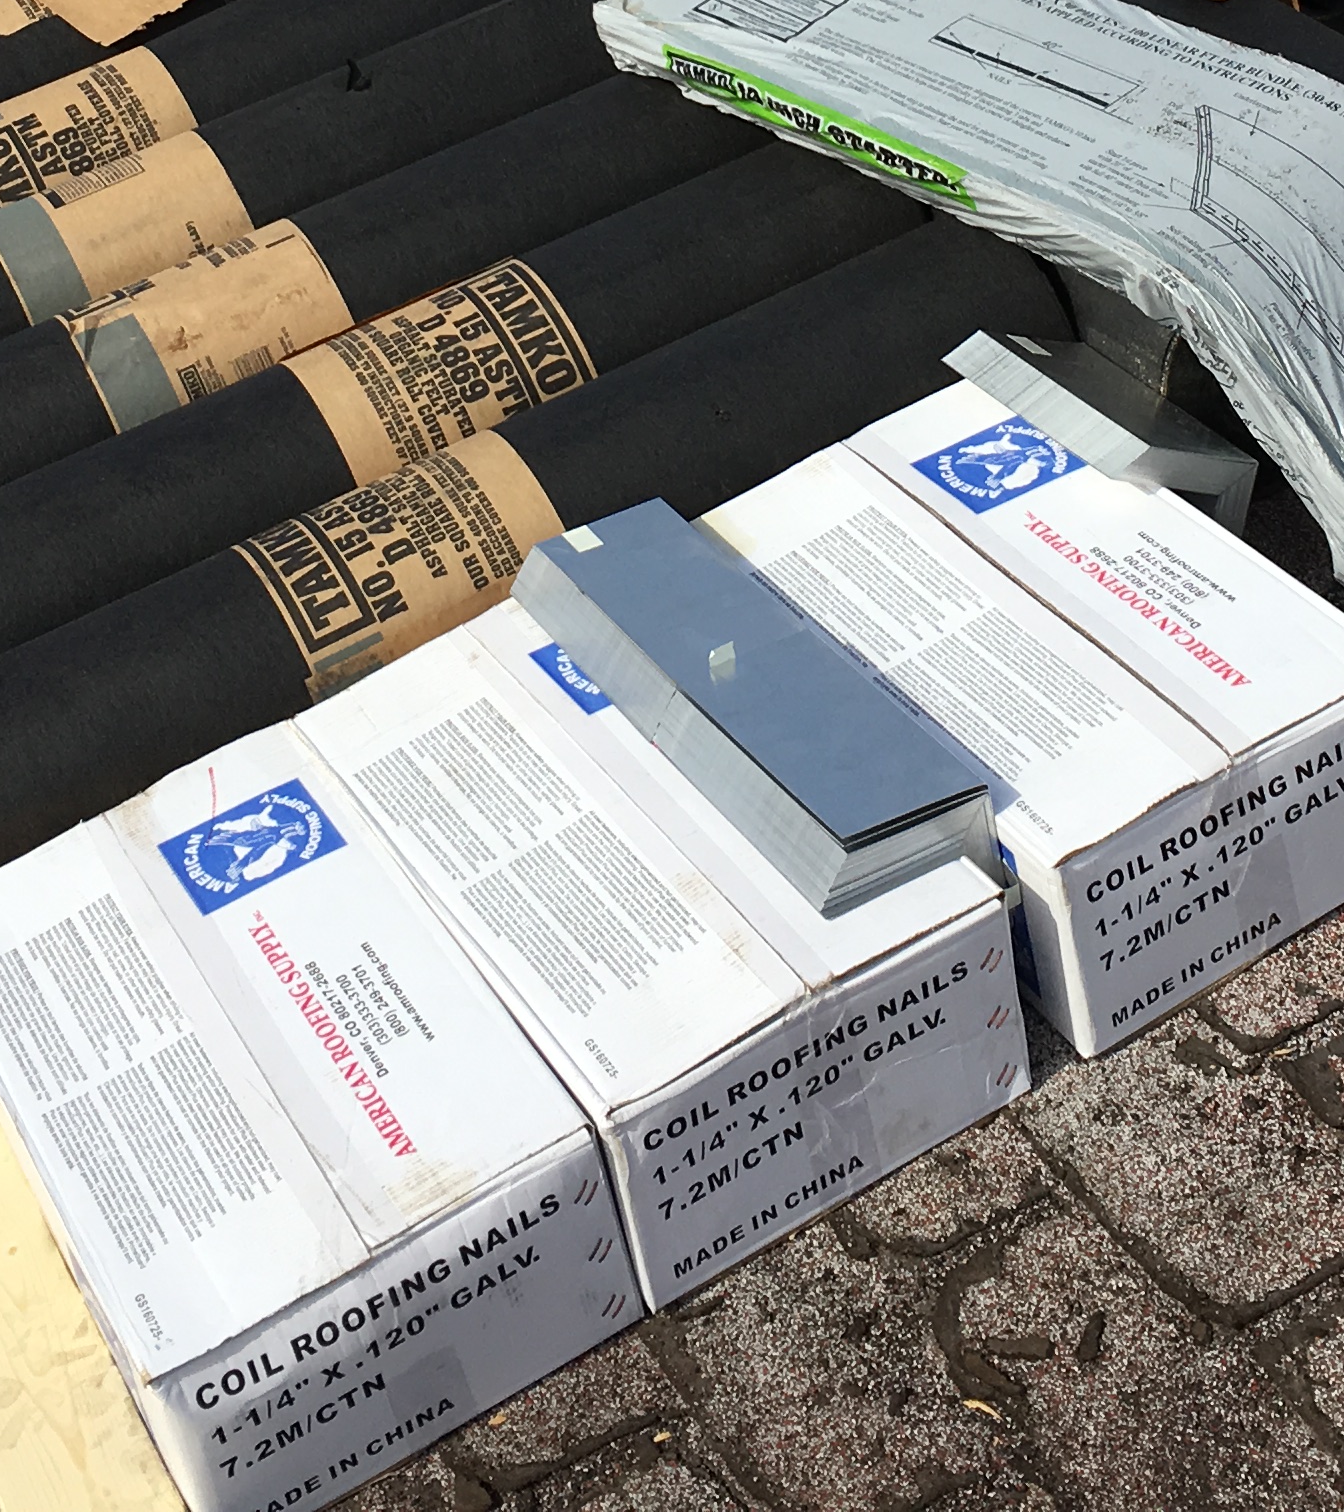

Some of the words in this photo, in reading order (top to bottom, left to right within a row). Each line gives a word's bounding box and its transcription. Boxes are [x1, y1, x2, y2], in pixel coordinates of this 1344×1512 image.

[1044, 5, 1096, 29] APPLIED
[1093, 27, 1171, 58] ACCORDING
[1172, 51, 1193, 65] TO
[1191, 59, 1294, 103] INSTRUCTIONS
[1127, 26, 1150, 38] 100
[1147, 32, 1200, 56] LINEAR
[1198, 50, 1218, 63] FT
[1217, 54, 1247, 73] PER
[1246, 65, 1307, 93] BUNDLE
[1302, 85, 1342, 114] (30.48
[12, 112, 68, 178] ASTM
[53, 127, 95, 177] 869
[88, 116, 113, 151] FELT
[109, 125, 133, 159] ROLL
[416, 311, 447, 333] D
[434, 333, 491, 405] 4869
[452, 311, 492, 342] 15
[477, 272, 578, 396] TAMKO
[368, 329, 405, 368] SQUARE
[396, 367, 426, 404] ROLL
[389, 330, 430, 378] ORGANIC
[420, 378, 451, 417] FELT
[391, 314, 432, 353] ASPHALT
[423, 352, 477, 439] SATURATED
[382, 419, 401, 446] FEET
[995, 424, 1047, 441] SUPPLY
[937, 454, 1004, 500] AMERICAN
[333, 527, 376, 562] 15
[397, 512, 449, 580] ASPHALT
[404, 487, 448, 544] ORGANIC
[427, 496, 471, 554] SQUARE
[1022, 518, 1089, 568] SUPPLY
[381, 537, 420, 567] D
[477, 538, 504, 579] COVERS
[1089, 545, 1148, 590] 80217-2688
[1122, 554, 1196, 606] (303)333-3700
[1135, 547, 1185, 581] 249-3701
[1136, 530, 1238, 604] www.amroofing.com
[360, 559, 410, 625] NO.
[1080, 561, 1164, 621] ROOFING
[1145, 588, 1164, 602] CO
[1164, 598, 1203, 630] Denver,
[1180, 577, 1211, 600] (800)
[557, 648, 601, 695] MERICA
[1153, 614, 1254, 688] AMERICAN
[257, 793, 312, 816] SUPPLY
[298, 809, 324, 860] ROOFING
[182, 832, 240, 895] AMERICAN
[1086, 854, 1154, 904] COIL
[1159, 774, 1288, 863] ROOFING
[1094, 877, 1172, 938] 1-1/4"
[1180, 862, 1201, 888] X
[1207, 816, 1276, 872] .120"
[247, 918, 302, 987] SUPPLY
[1099, 879, 1232, 973] 7.2M/CTN
[303, 959, 351, 1021] 80217-2688
[351, 963, 390, 1010] 249-3701
[359, 940, 436, 1043] www.amroofing.com
[1111, 976, 1176, 1029] MADE
[1181, 957, 1206, 984] IN
[1210, 911, 1283, 966] CHINA
[288, 981, 357, 1071] ROOFING
[334, 972, 393, 1047] (303)333-3700
[343, 1018, 362, 1040] CO
[385, 1004, 411, 1040] (800)
[360, 1036, 389, 1078] Denver,
[642, 1101, 720, 1152] COIL
[726, 1014, 869, 1107] ROOFING
[877, 960, 969, 1023] NAILS
[338, 1049, 419, 1158] AMERICAN
[652, 1121, 739, 1186] 1-1/4"
[747, 1108, 769, 1131] X
[778, 1054, 855, 1116] .120"
[862, 1007, 947, 1063] GALV.
[657, 1121, 805, 1221] 7.2M/CTN
[672, 1225, 746, 1280] MADE
[752, 1203, 779, 1231] IN
[784, 1154, 865, 1211] CHINA
[194, 1351, 285, 1411] COIL
[289, 1257, 453, 1364] ROOFING
[458, 1192, 561, 1267] NAILS
[211, 1377, 310, 1445] 1-1/4"
[320, 1360, 347, 1388] X
[355, 1303, 440, 1368] .120"
[450, 1244, 541, 1310] GALV.
[219, 1372, 387, 1479] 7.2M/CTN
[256, 1474, 323, 1511] ADE
[328, 1452, 359, 1480] IN
[365, 1396, 456, 1456] CHINA
